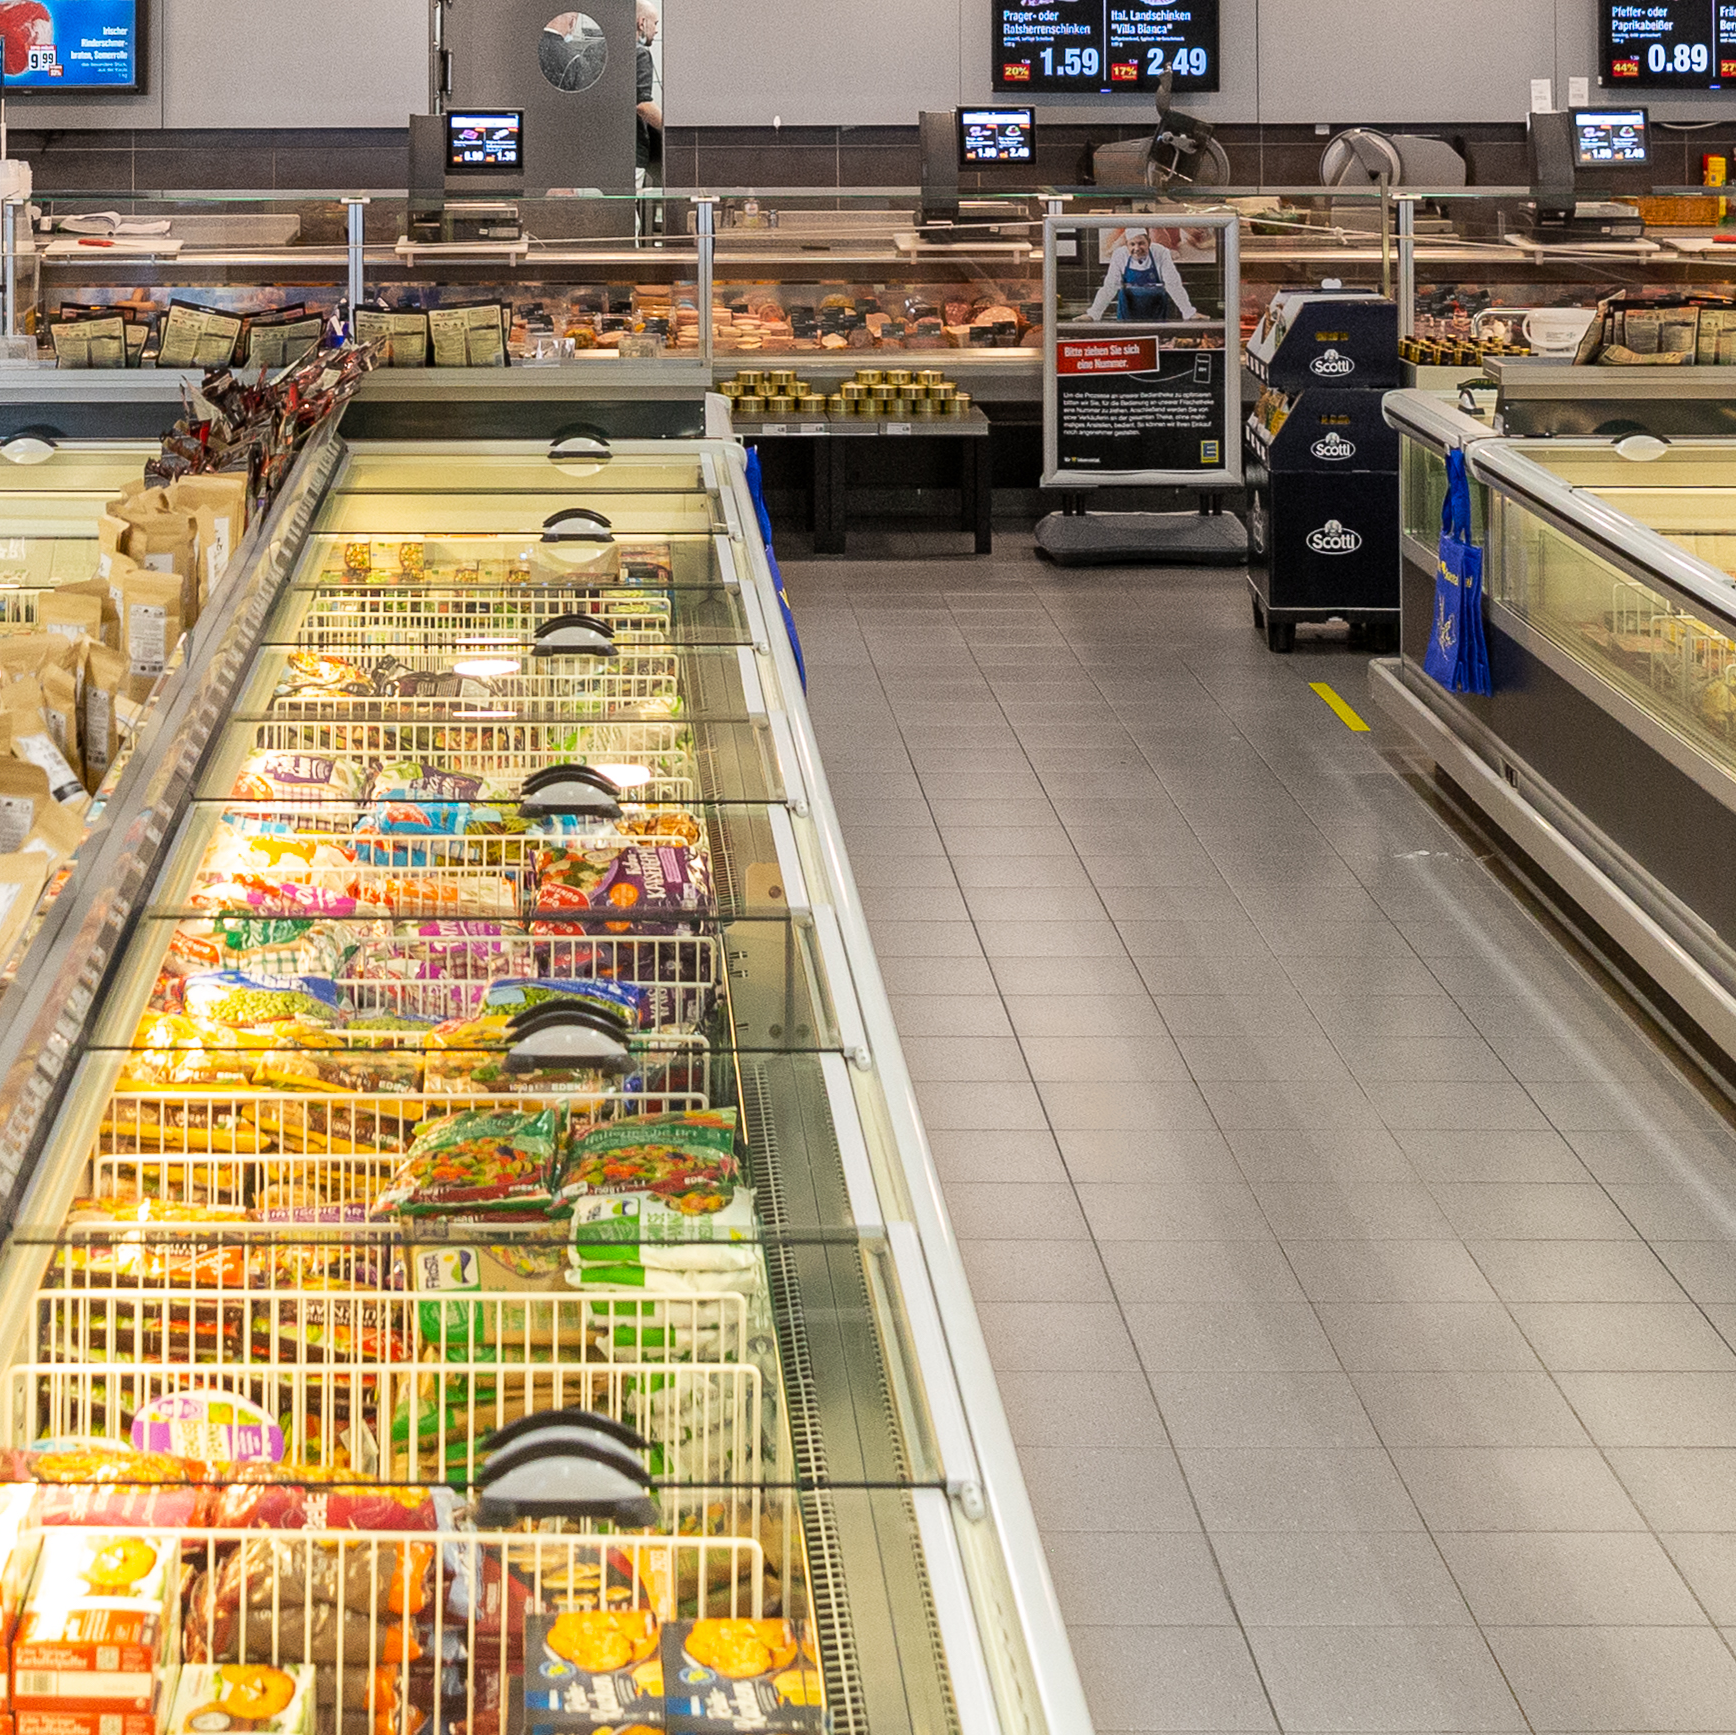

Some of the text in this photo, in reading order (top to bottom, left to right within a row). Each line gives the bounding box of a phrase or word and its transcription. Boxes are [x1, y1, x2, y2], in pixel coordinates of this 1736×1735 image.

[1004, 10, 1059, 22] Prager- oder
[1111, 10, 1191, 21] Ital. Landschinken
[1612, 6, 1667, 17] Pfeffer- oder
[1003, 23, 1091, 34] Ratsherrenschinken
[1612, 20, 1673, 31] Paprikabeißer
[1040, 48, 1099, 76] 1.59
[1147, 48, 1207, 76] 249
[1648, 43, 1708, 73] 0.89
[1004, 67, 1029, 76] 20%
[1113, 67, 1137, 76] 17%
[1613, 64, 1638, 73] 44%
[1065, 344, 1140, 356] Bitte ziehen Sie sich
[1077, 359, 1129, 369] eine Nummer.
[1314, 360, 1349, 374] Scotti
[1316, 444, 1350, 456] Scotti
[1312, 534, 1355, 549] Scotti
[551, 1082, 592, 1092] EDEKA
